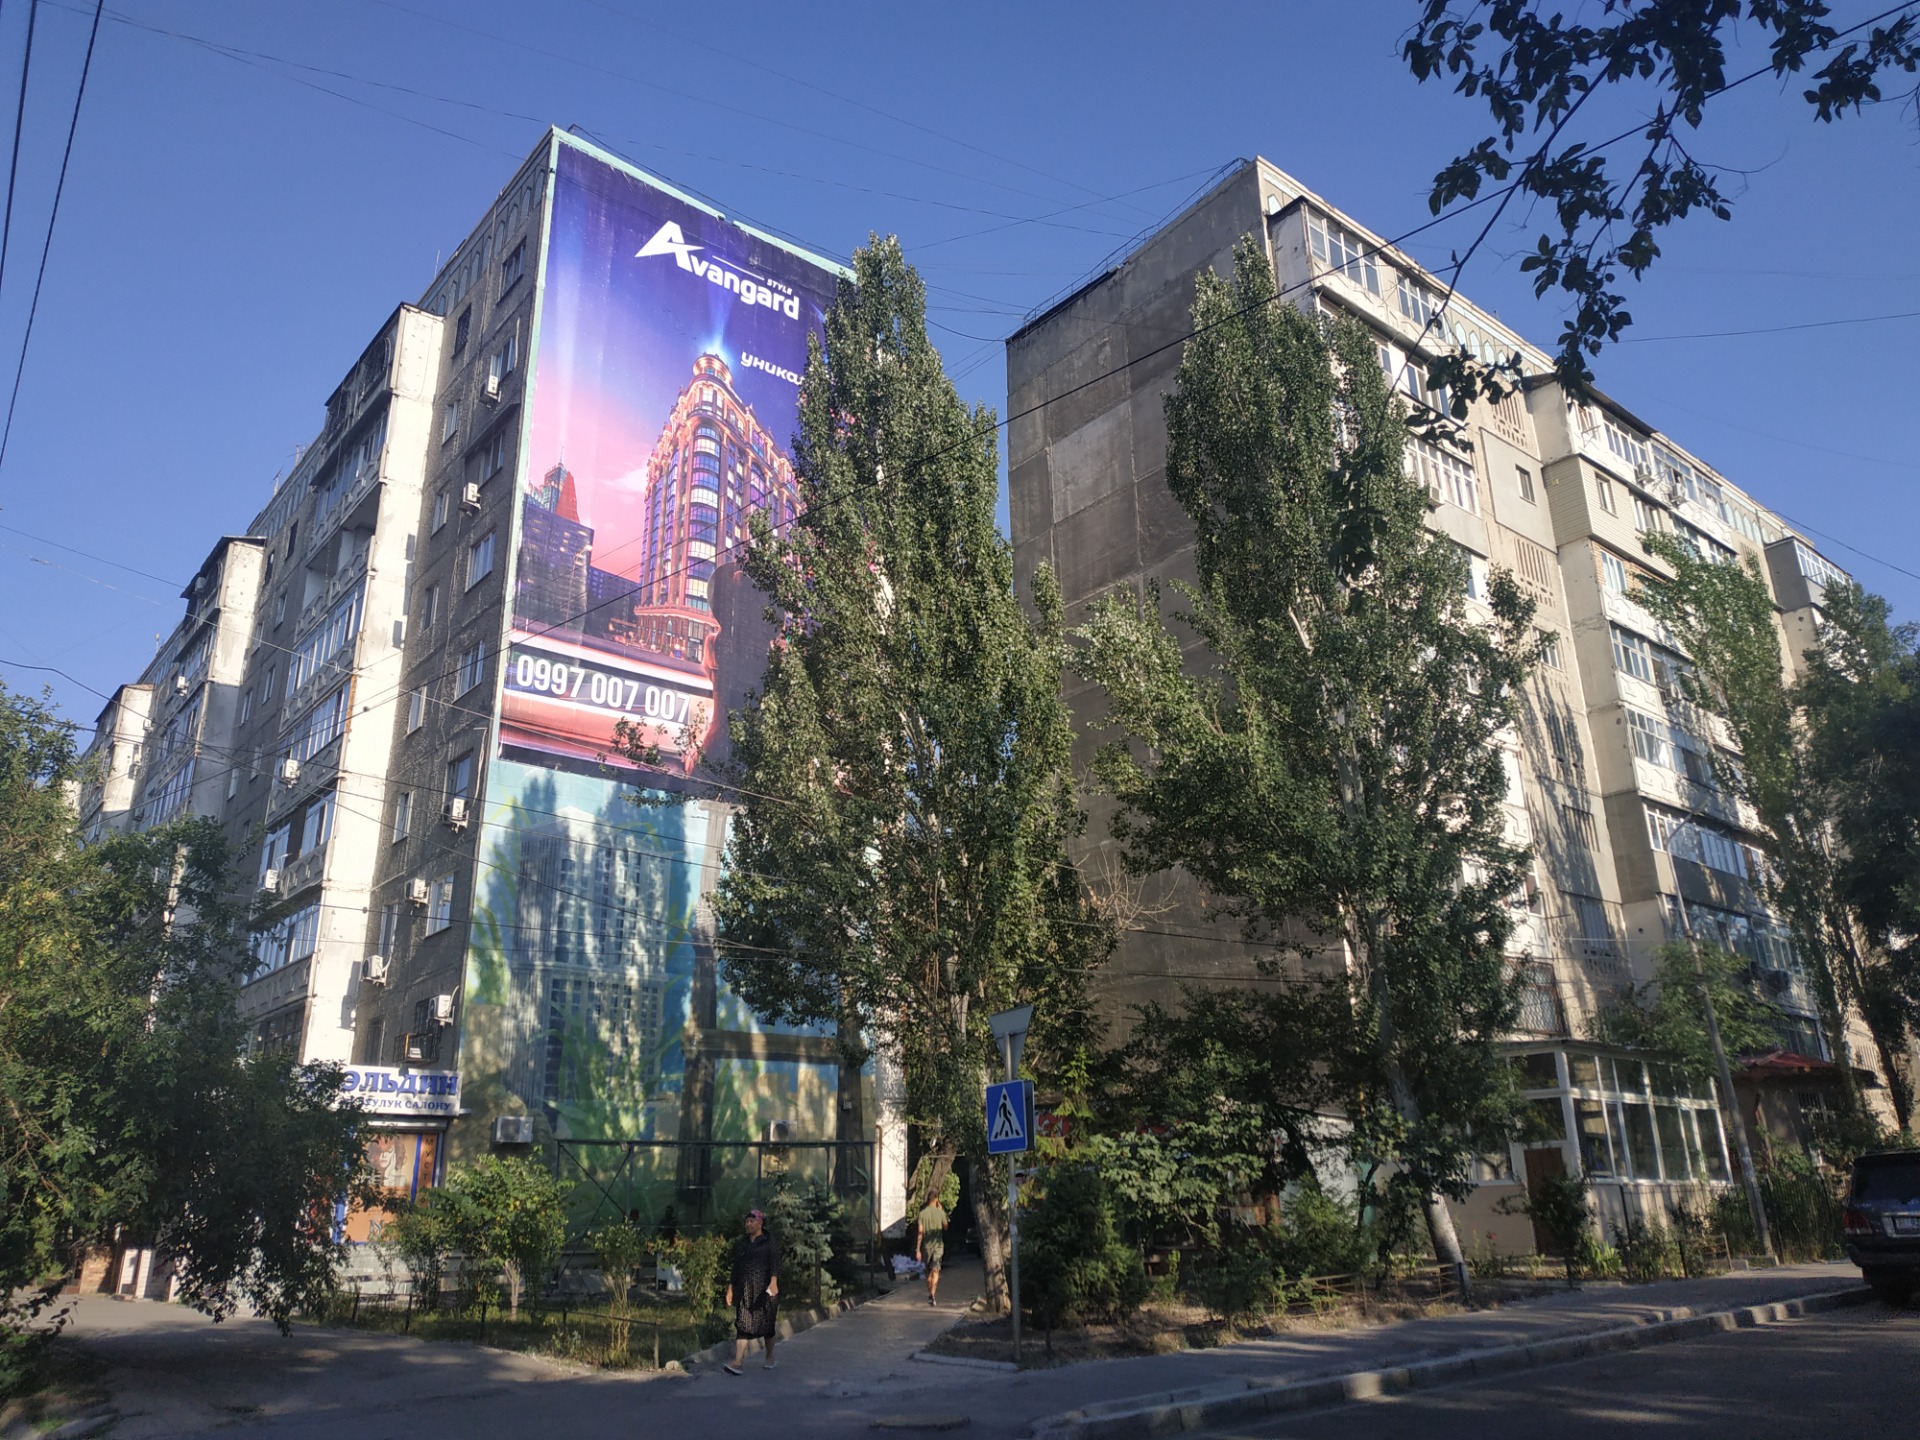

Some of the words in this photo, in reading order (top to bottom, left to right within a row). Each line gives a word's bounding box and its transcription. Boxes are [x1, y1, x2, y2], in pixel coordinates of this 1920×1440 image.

[634, 220, 800, 321] Avangard
[766, 278, 793, 297] STYLE
[516, 655, 585, 698] 0997
[590, 672, 639, 711] 007
[644, 686, 690, 723] 007
[404, 1100, 452, 1111] САЛОНУ
